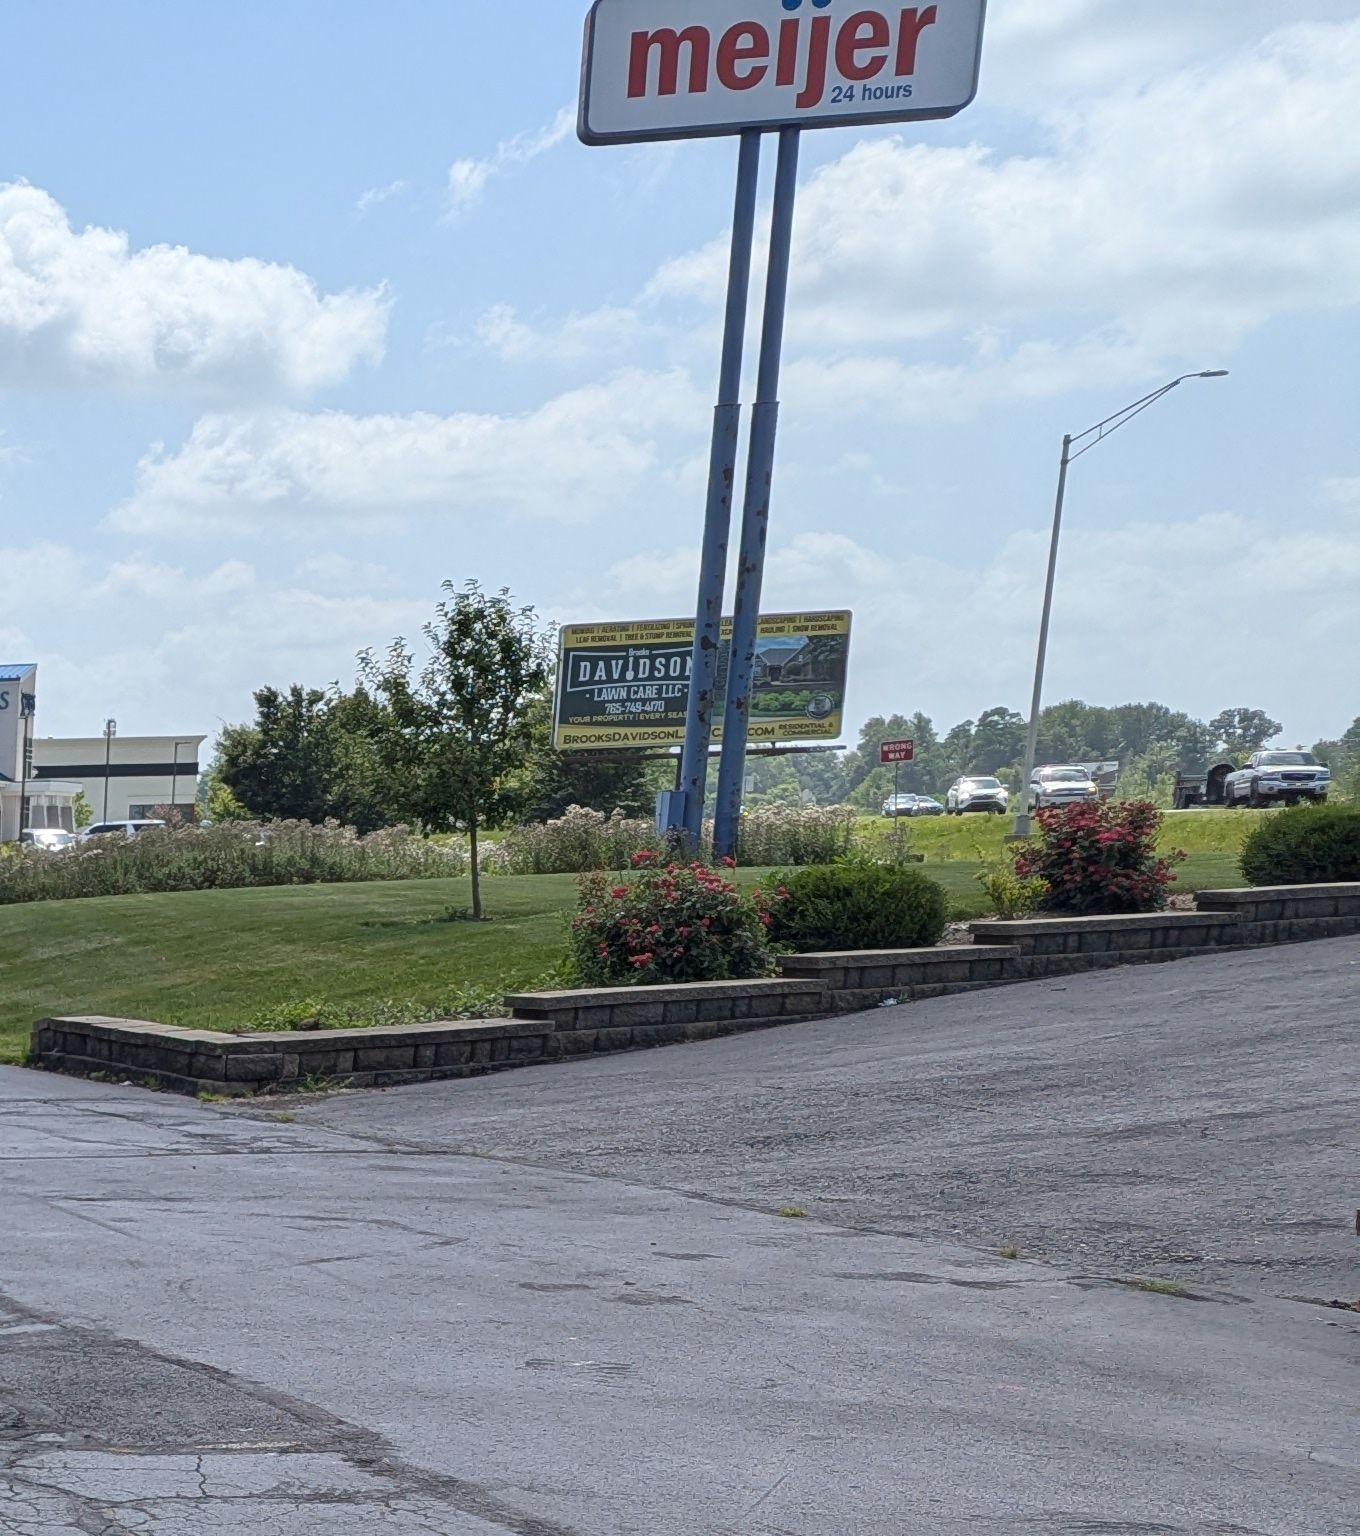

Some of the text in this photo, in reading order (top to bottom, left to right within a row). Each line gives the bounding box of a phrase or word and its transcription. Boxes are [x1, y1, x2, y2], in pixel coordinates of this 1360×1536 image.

[626, 0, 937, 108] meijer
[830, 83, 913, 103] 24 hours
[593, 684, 682, 701] LAWN CARE LLC
[568, 715, 591, 724] YOUR
[592, 713, 634, 723] PROPERTY
[639, 712, 666, 721] EVERY
[778, 722, 826, 730] RESIDENTIAL
[782, 728, 833, 736] COMMERCIAL
[882, 742, 913, 751] WRONG
[888, 751, 906, 760] WAY
